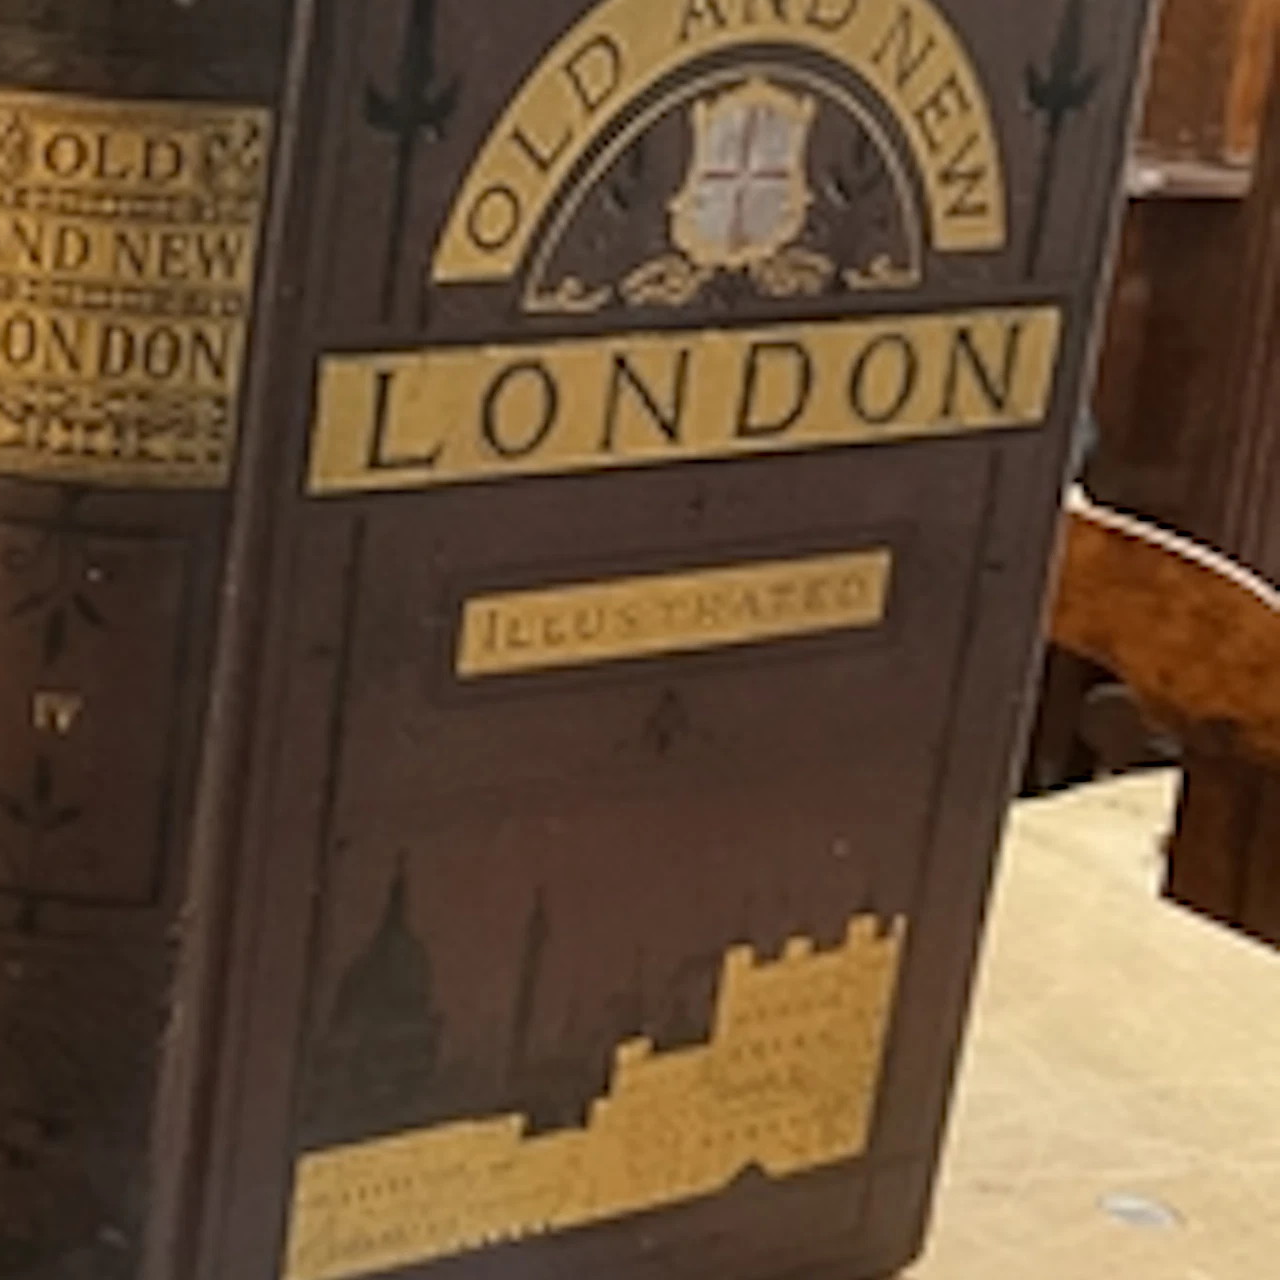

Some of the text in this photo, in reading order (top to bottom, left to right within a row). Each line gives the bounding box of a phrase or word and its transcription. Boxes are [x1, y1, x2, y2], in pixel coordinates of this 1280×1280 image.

[44, 131, 186, 184] OLD
[465, 34, 626, 252] OLD
[872, 8, 989, 224] NEW
[114, 230, 240, 283] NEW
[366, 325, 1022, 470] LONDON
[480, 572, 870, 654] ILLUSTRATED
